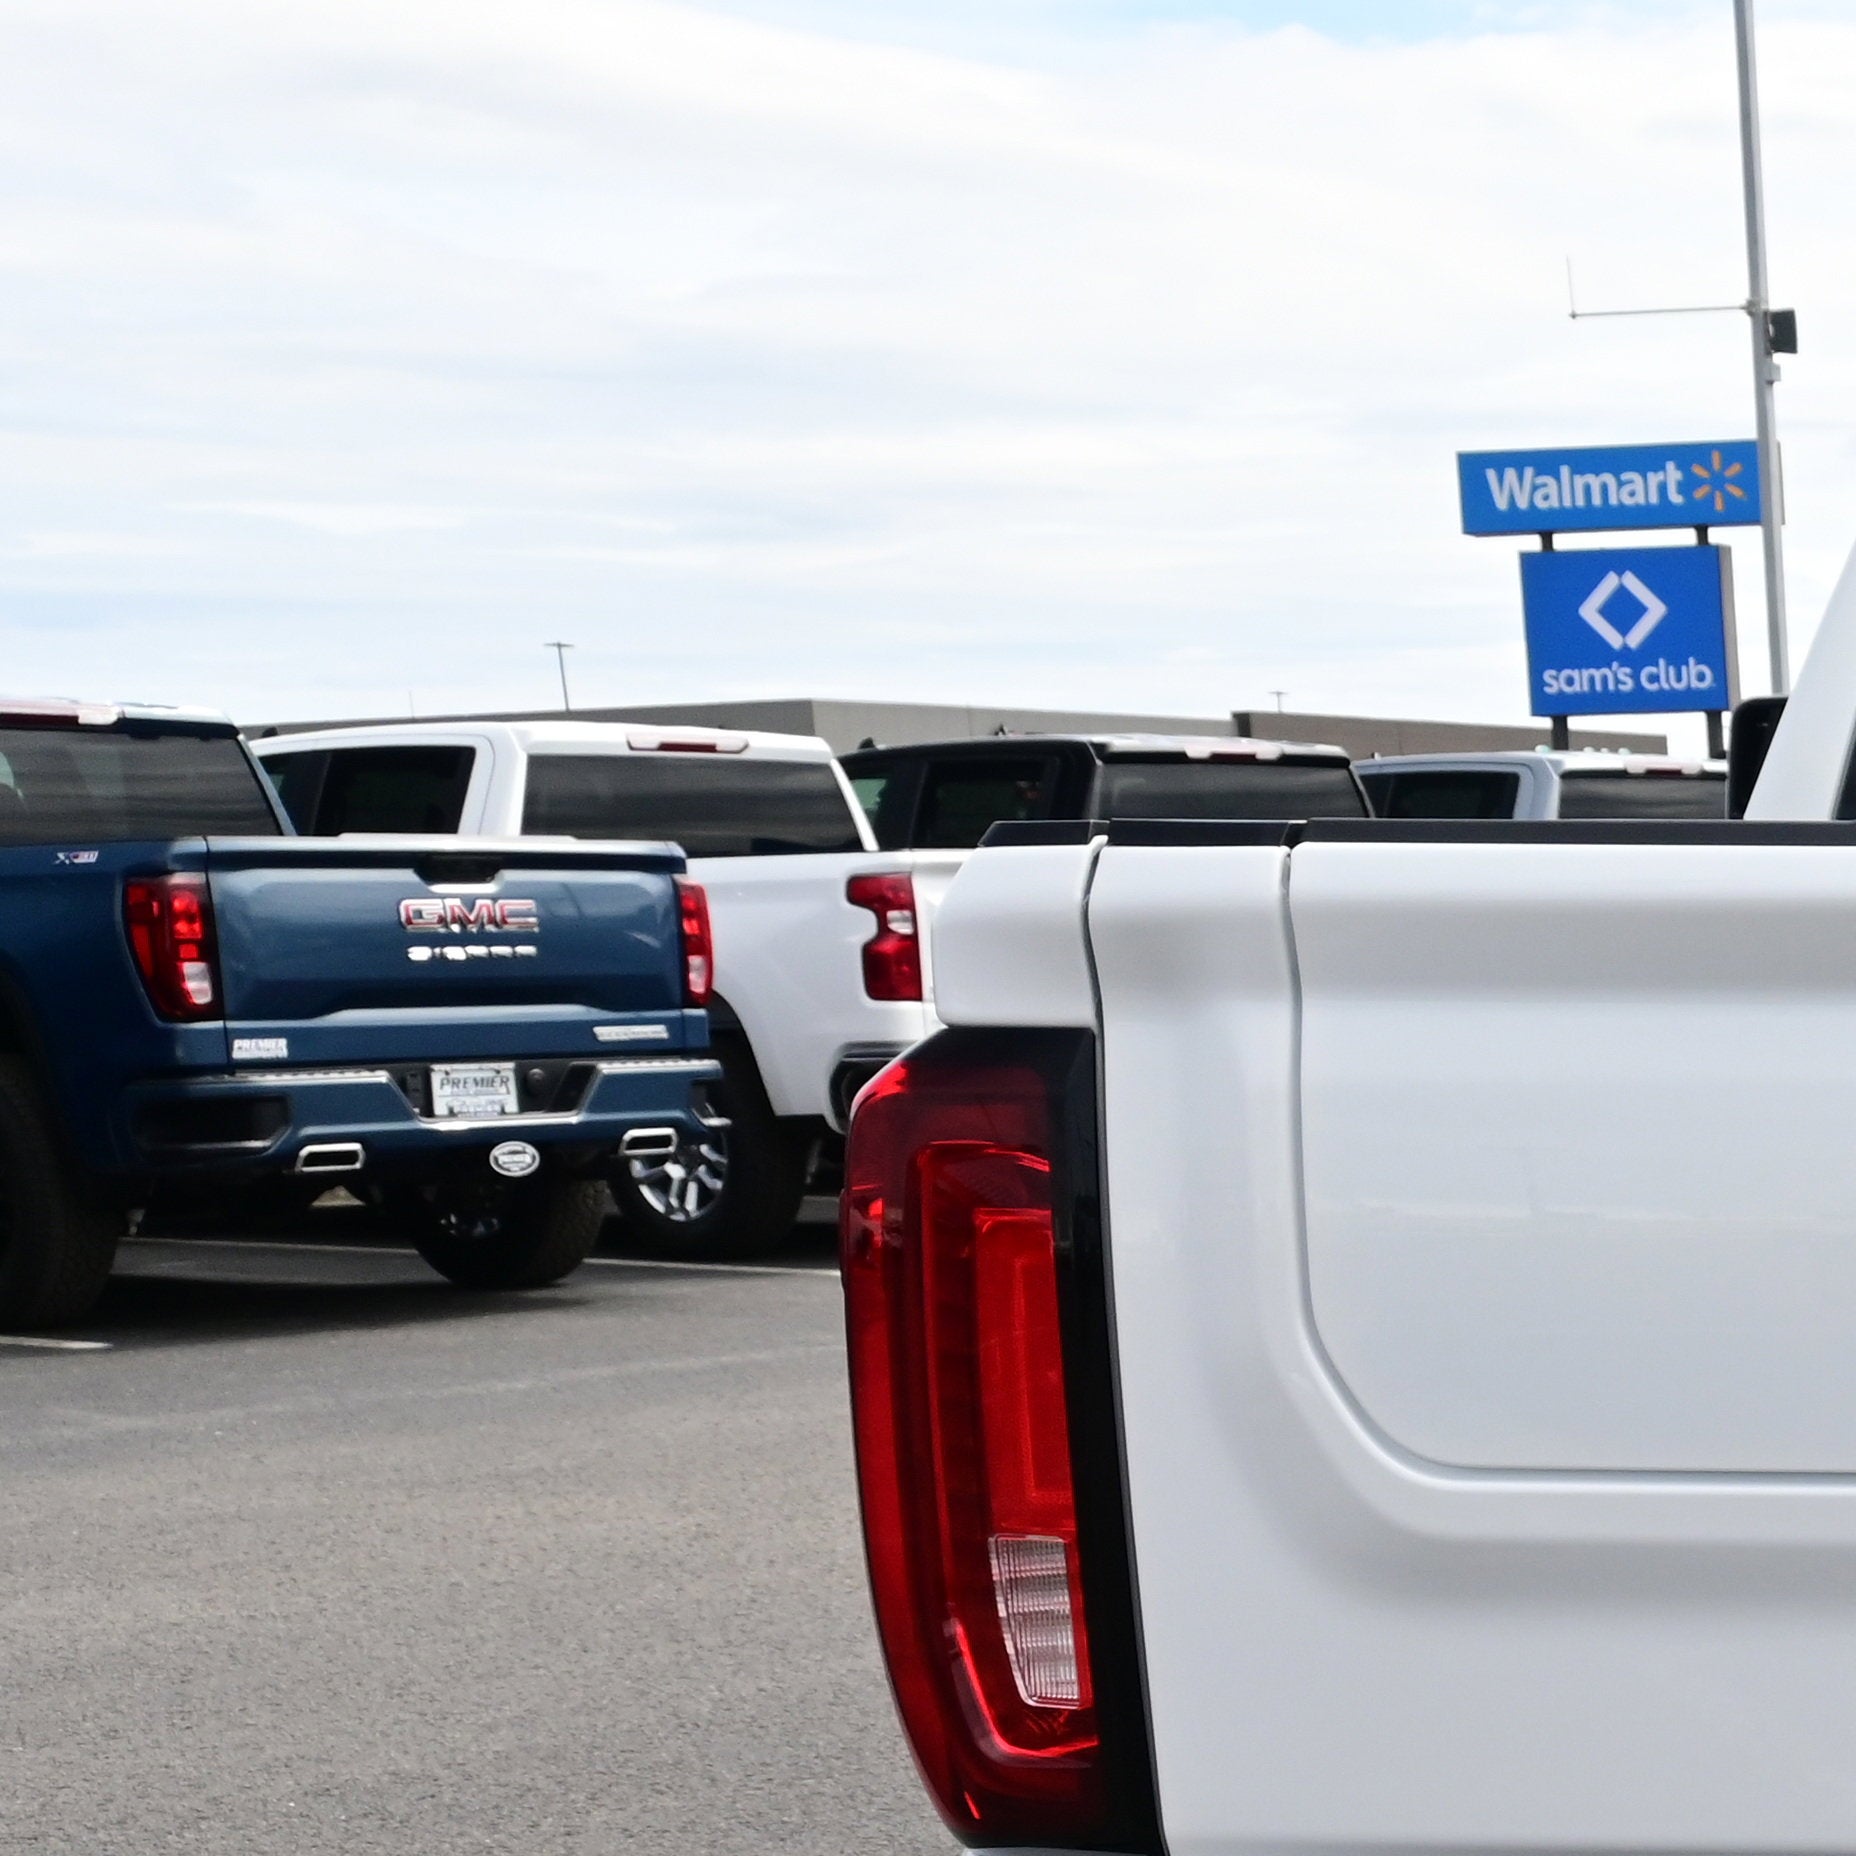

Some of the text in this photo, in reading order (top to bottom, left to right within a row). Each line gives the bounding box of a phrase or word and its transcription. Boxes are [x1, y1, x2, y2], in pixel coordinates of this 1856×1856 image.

[1485, 461, 1684, 511] Walmart
[1542, 657, 1714, 694] sam's club
[399, 898, 538, 932] GMC
[440, 1076, 511, 1094] PREMIER
